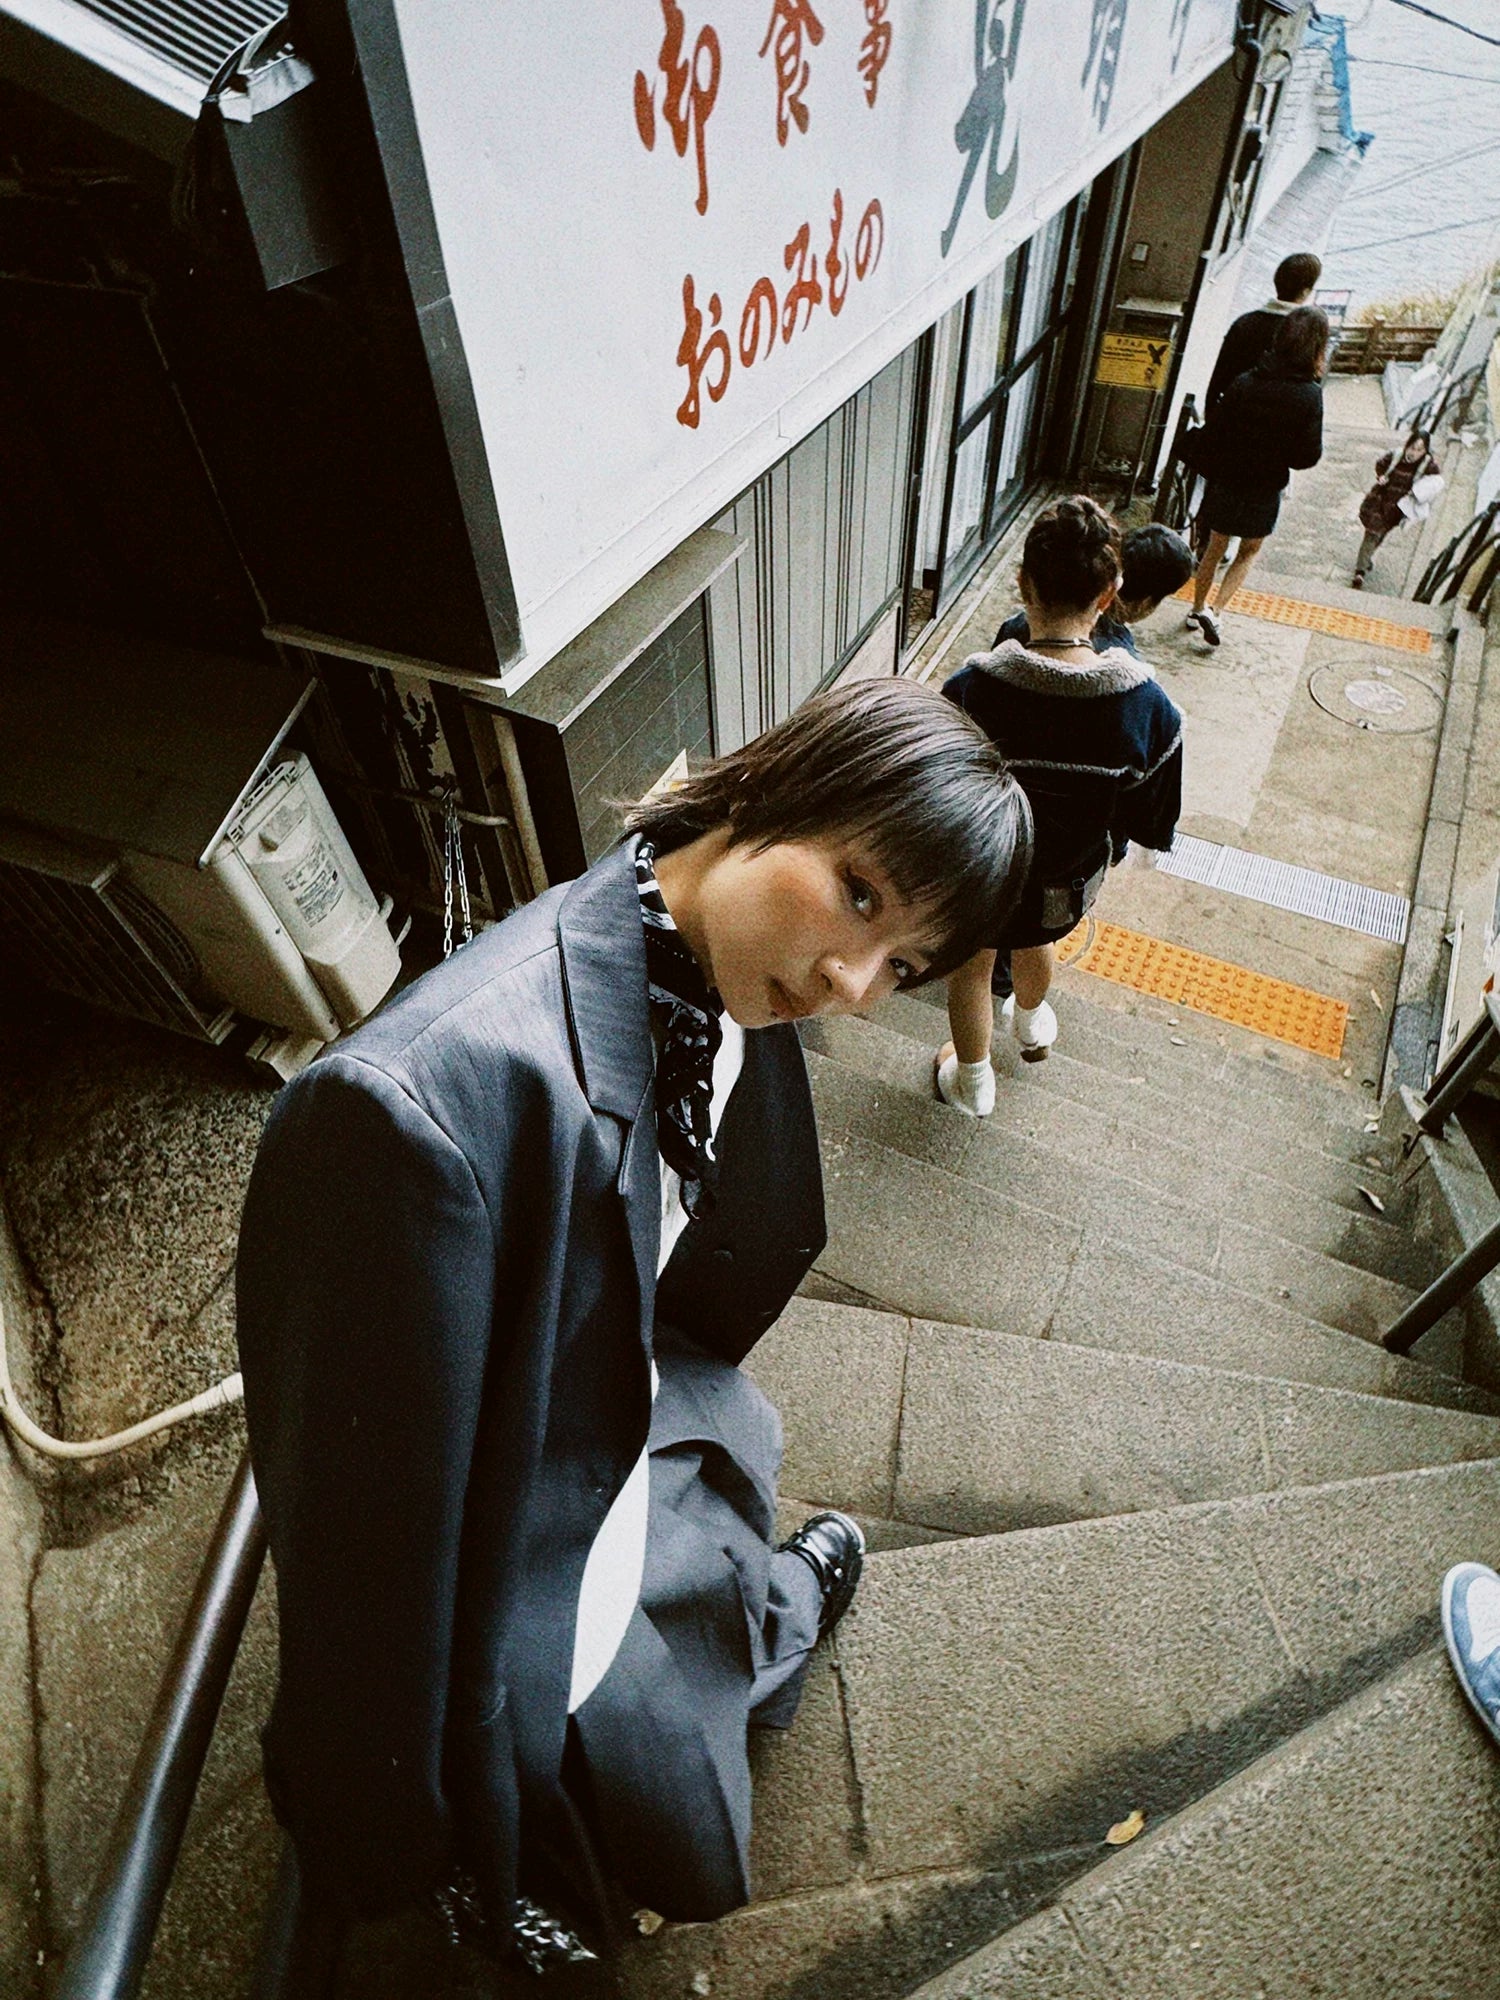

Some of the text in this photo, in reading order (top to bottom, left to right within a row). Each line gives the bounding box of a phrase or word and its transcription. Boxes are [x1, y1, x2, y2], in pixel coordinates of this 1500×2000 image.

[676, 188, 884, 429] おのみもの
